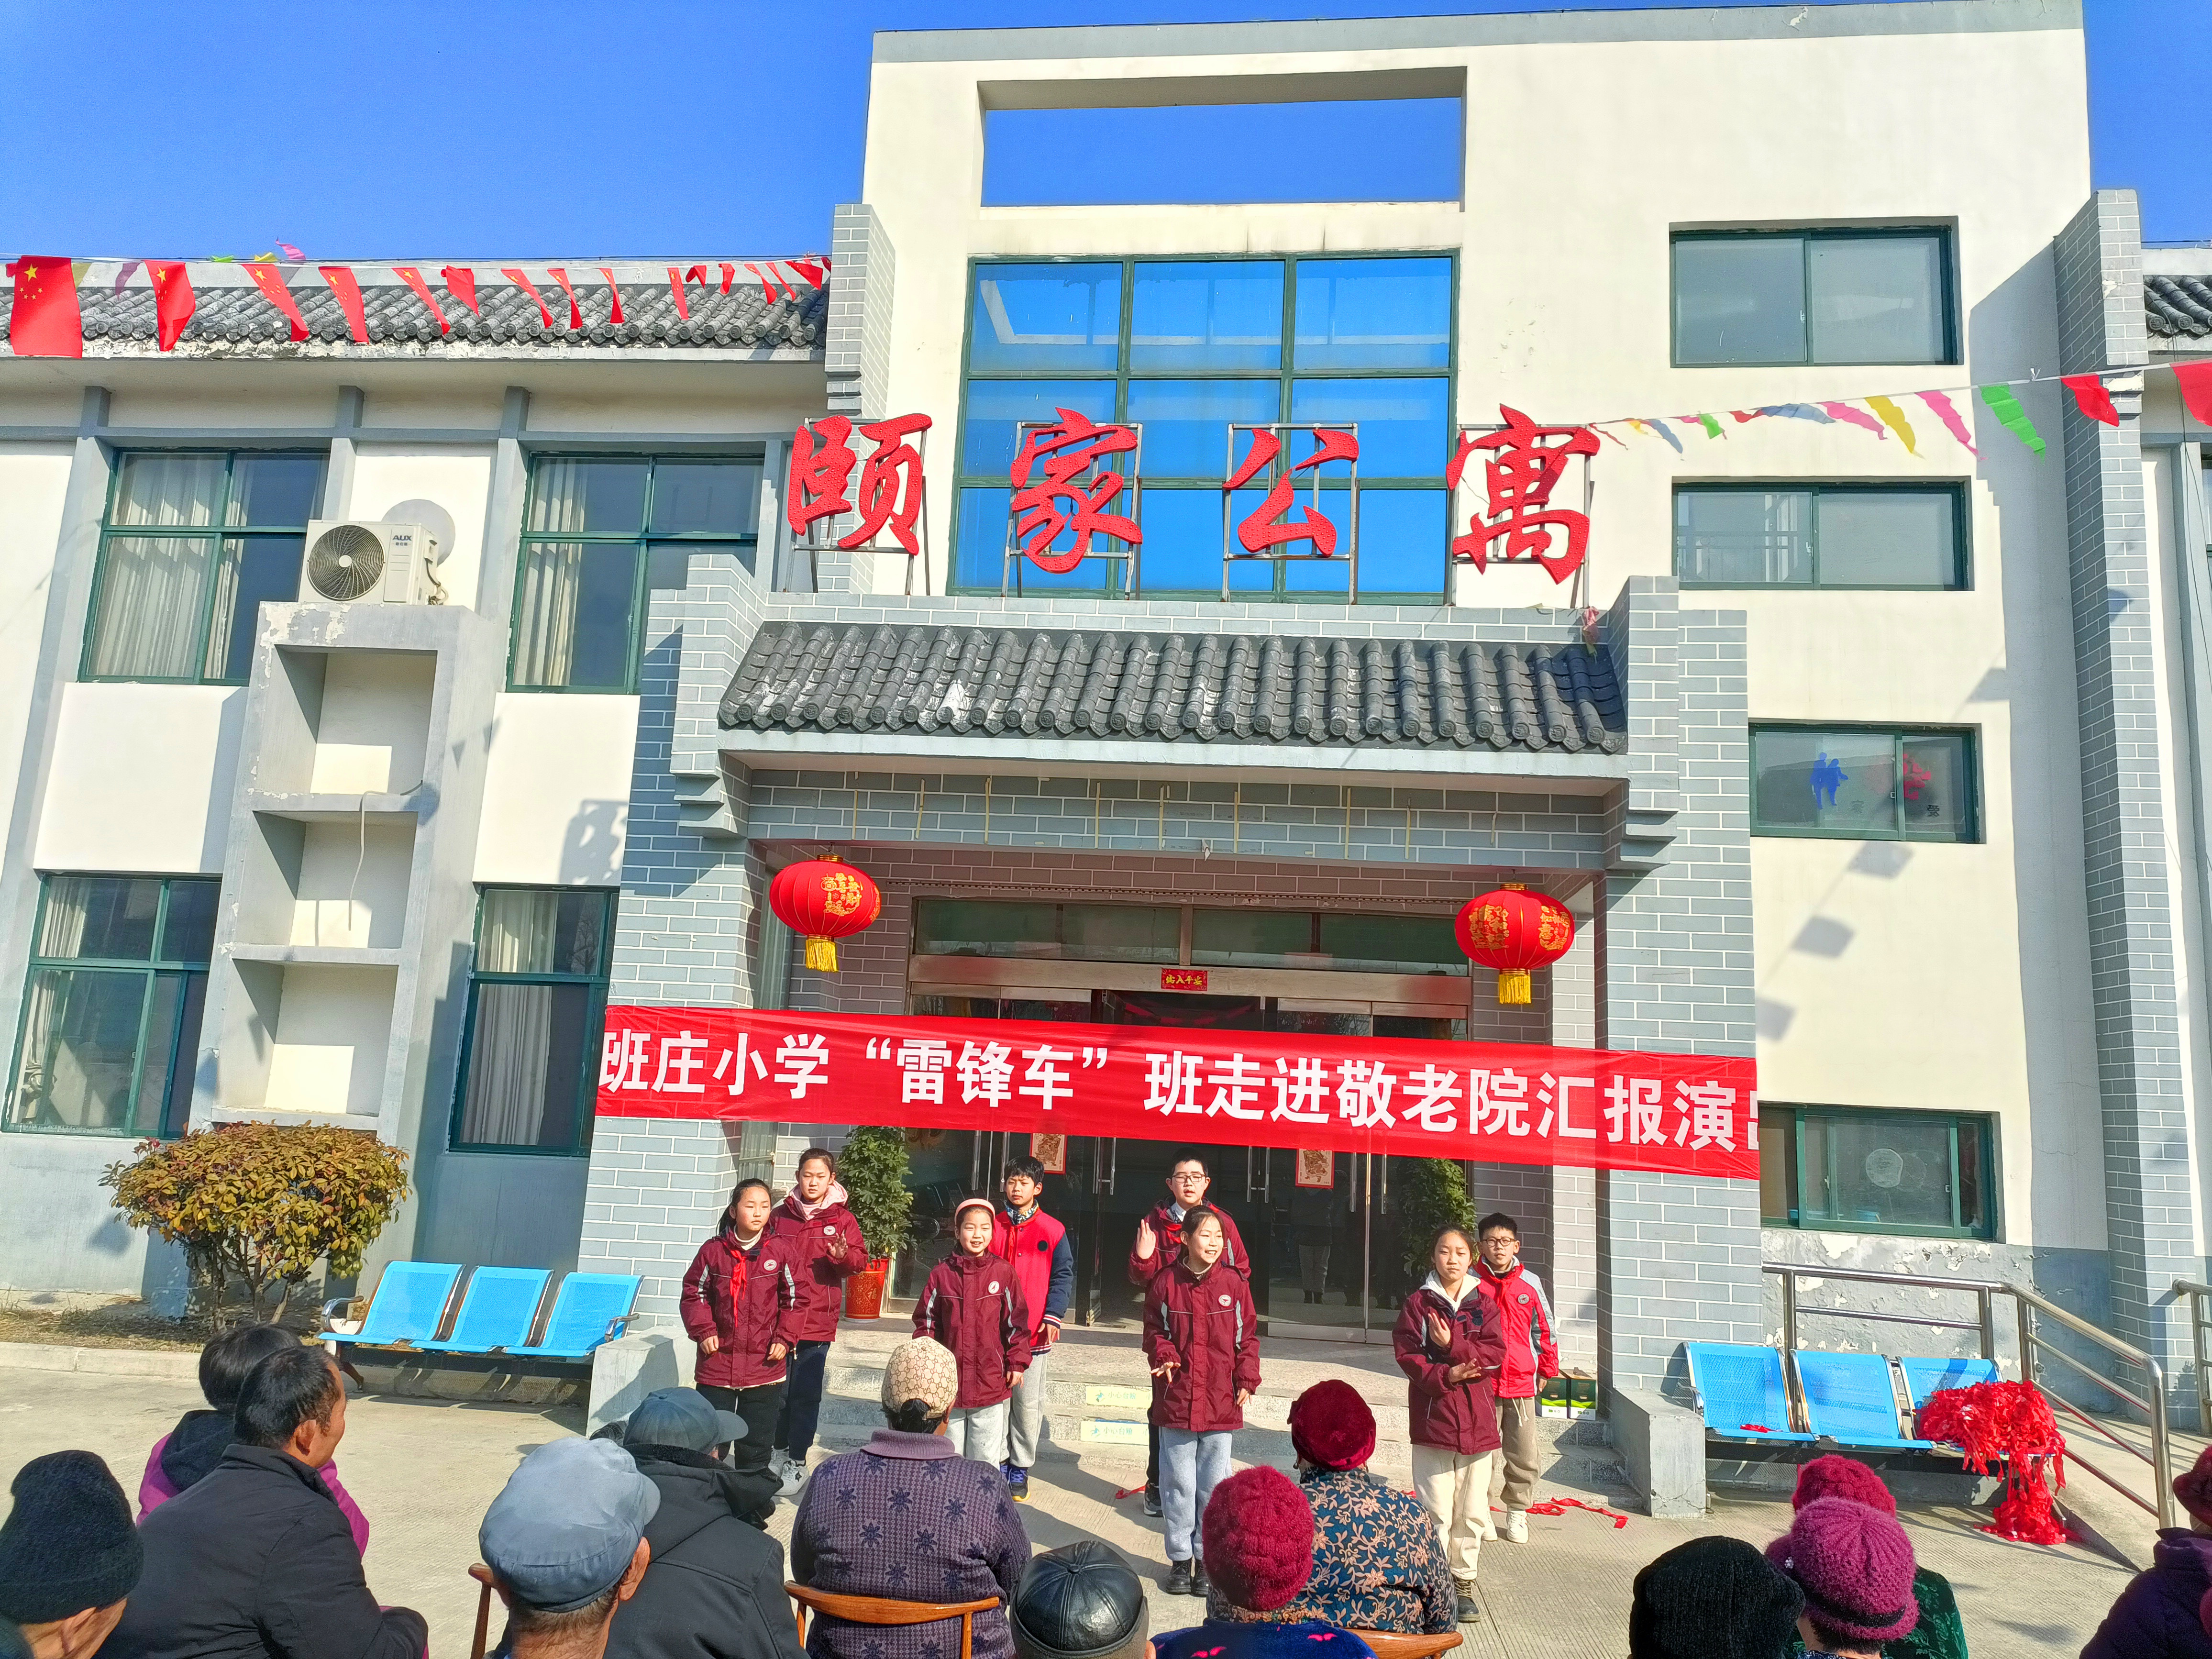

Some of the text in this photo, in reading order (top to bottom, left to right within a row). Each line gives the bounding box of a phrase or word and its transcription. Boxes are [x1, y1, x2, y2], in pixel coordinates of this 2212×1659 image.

[787, 404, 1601, 585] 颐家公寓
[598, 1028, 1759, 1153] 班庄小学“雷锋车”班走进敬老院汇报演
[867, 1287, 877, 1300] 福
